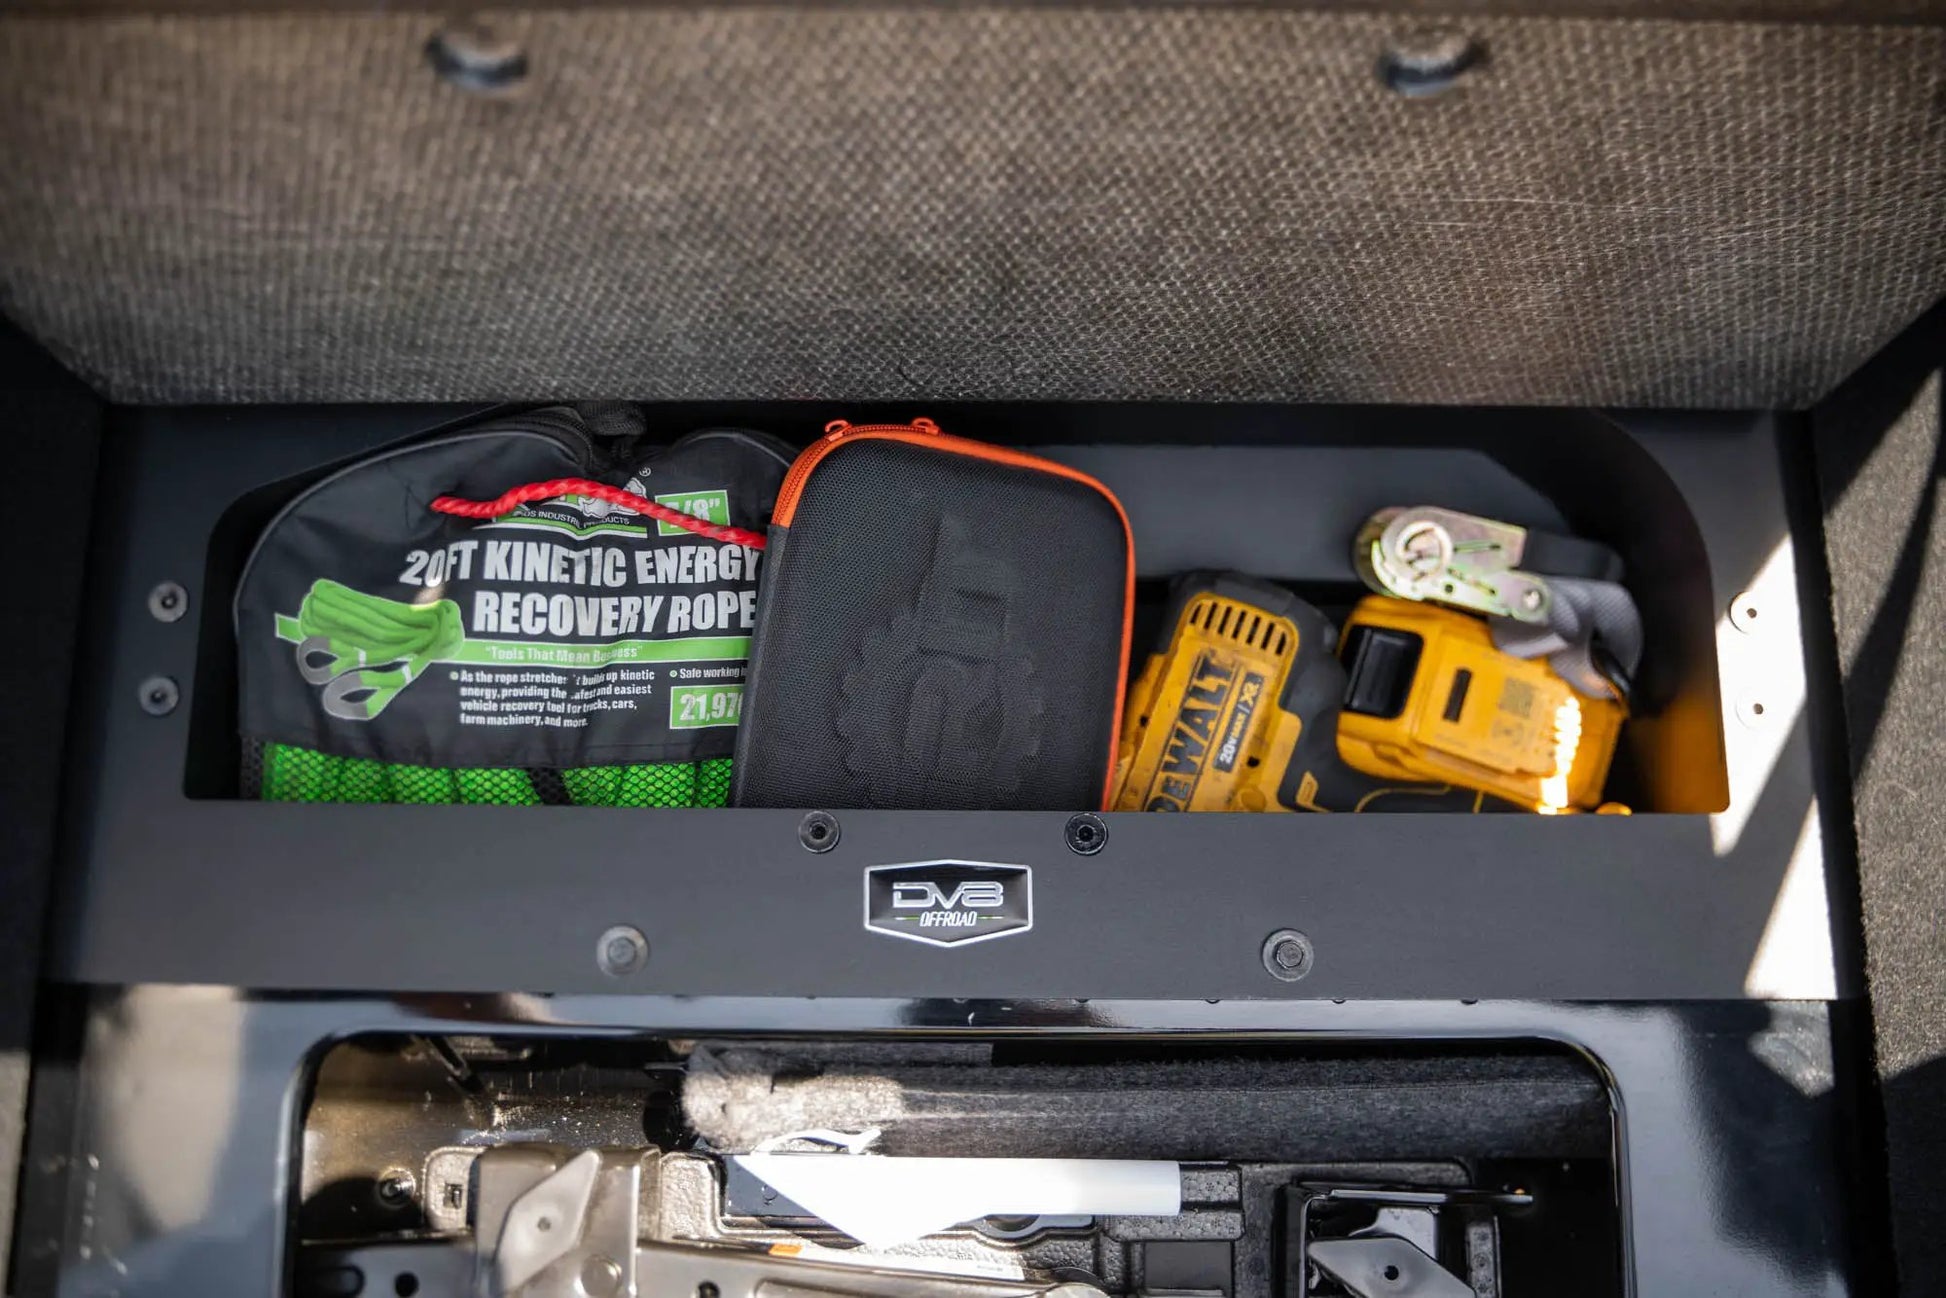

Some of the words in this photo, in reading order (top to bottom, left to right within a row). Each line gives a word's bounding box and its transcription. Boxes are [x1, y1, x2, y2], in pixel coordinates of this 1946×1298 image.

[583, 515, 630, 529] PDUCTS
[399, 540, 478, 587] 20FT
[484, 540, 627, 588] KINETIC
[635, 544, 760, 584] ENERGY
[473, 590, 664, 637] RECOVERY
[667, 590, 757, 633] ROPE
[528, 647, 554, 660] That
[556, 649, 590, 662] Mean
[461, 669, 474, 682] As
[475, 670, 493, 682] the
[494, 673, 518, 684] rope
[606, 671, 618, 683] up
[620, 669, 655, 681] kinetic
[680, 668, 702, 679] Safe
[703, 666, 740, 678] working
[460, 686, 501, 699] energy,
[501, 685, 549, 699] providing
[551, 687, 567, 699] the
[596, 684, 612, 696] and
[613, 684, 652, 695] easiest
[460, 700, 498, 712] vehicle
[500, 701, 545, 712] recovery
[546, 701, 565, 713] tool
[567, 702, 581, 714] for
[582, 698, 611, 713] trucks,
[612, 699, 638, 711] cars,
[460, 713, 486, 725] farm
[487, 714, 543, 727] machinery,
[544, 716, 561, 727] and
[893, 881, 1004, 909] DV8
[919, 911, 978, 927] OFFROAD
